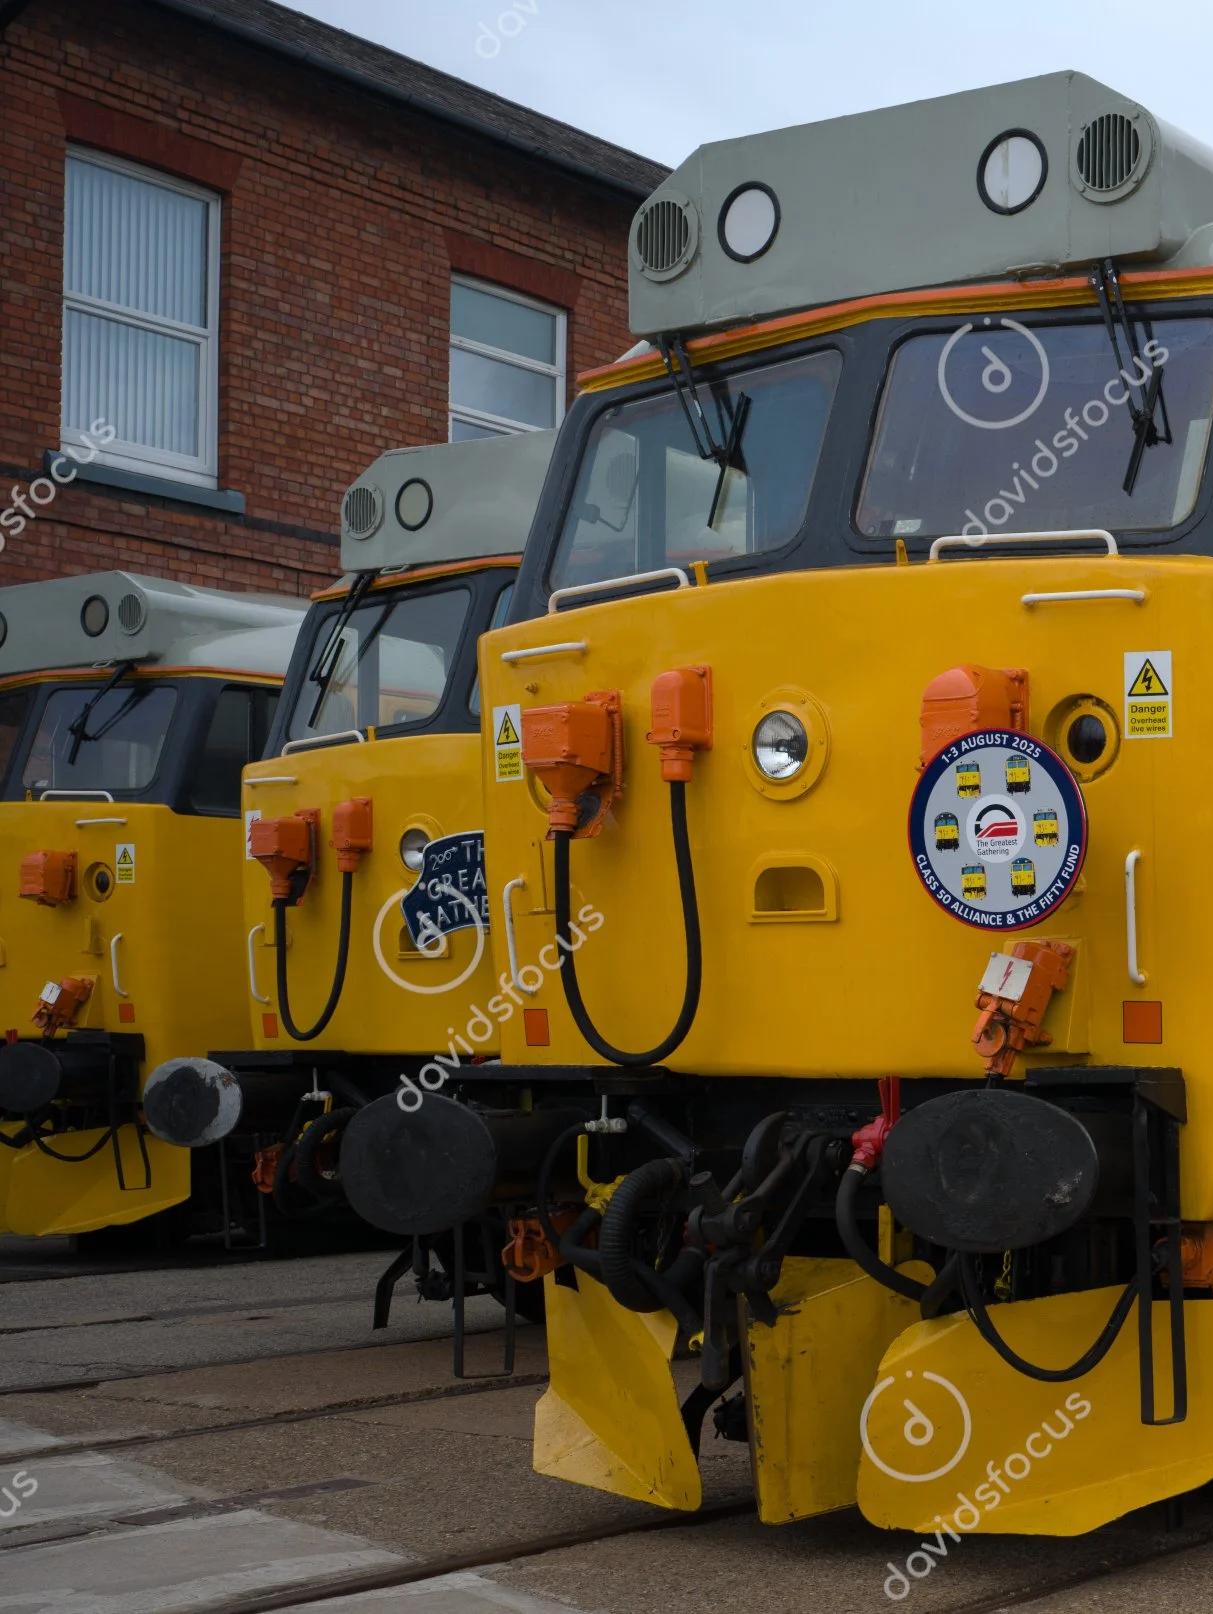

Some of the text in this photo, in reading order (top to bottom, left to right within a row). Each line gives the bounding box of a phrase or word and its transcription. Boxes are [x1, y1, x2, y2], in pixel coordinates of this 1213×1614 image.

[1130, 705, 1166, 714] Danger
[941, 747, 959, 764] 1-3
[961, 733, 1009, 752] AUGUST
[1011, 736, 1043, 759] 2025
[498, 752, 519, 760] Danger
[990, 838, 1018, 847] Greatest
[976, 848, 1010, 856] Gathering
[916, 844, 1080, 925] CLASS 50 ALLIANCE & THE FIFTY FUND
